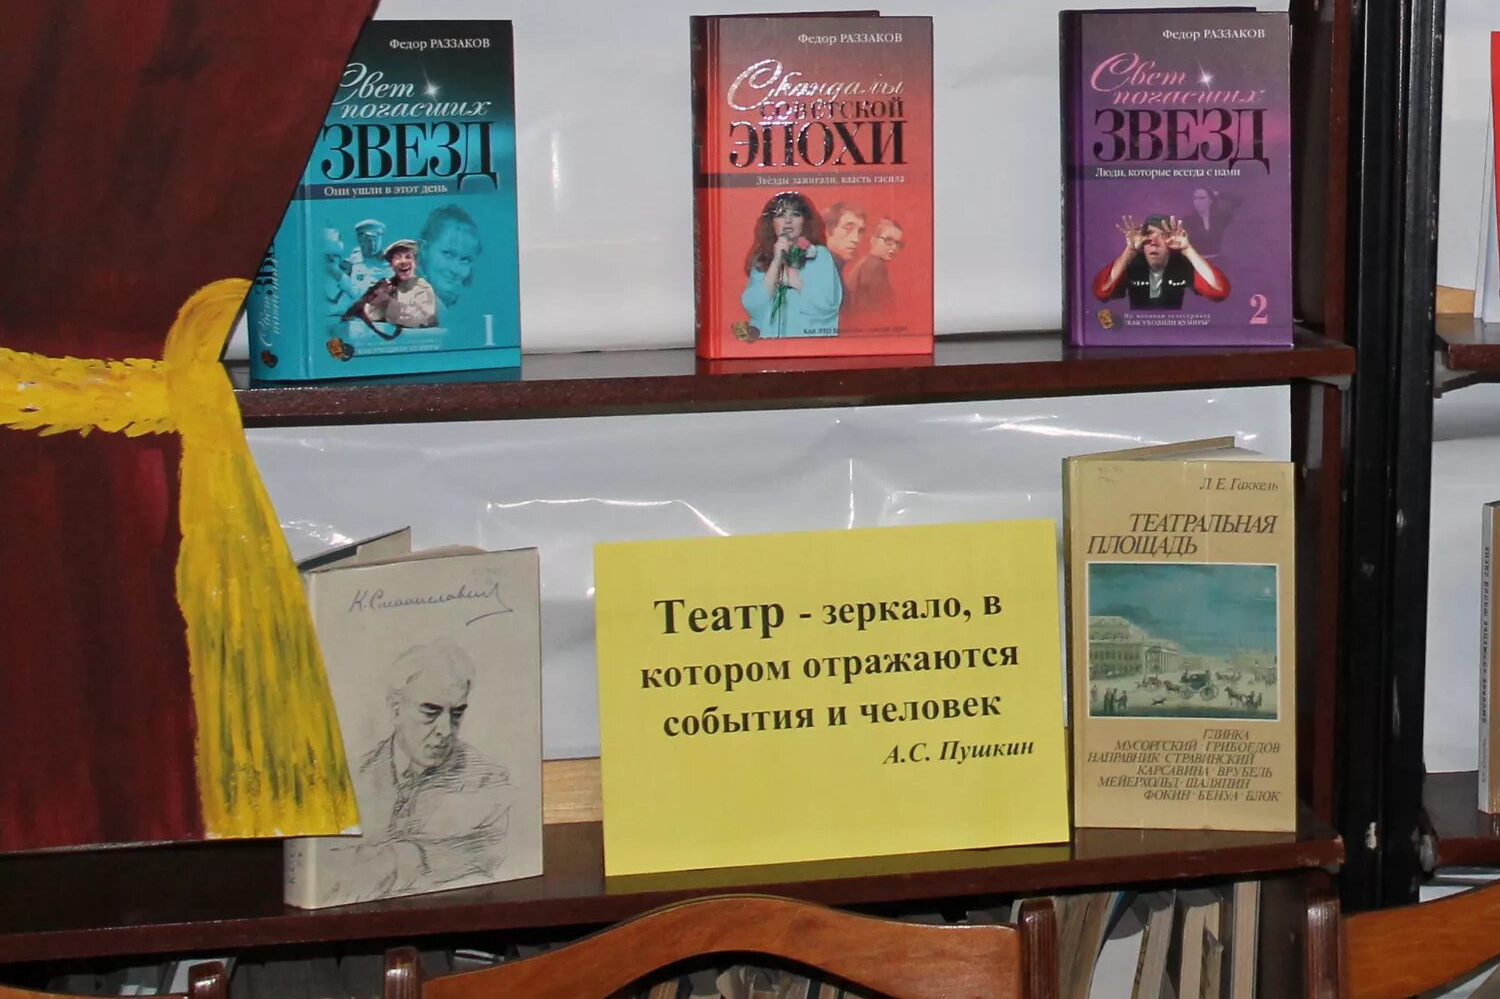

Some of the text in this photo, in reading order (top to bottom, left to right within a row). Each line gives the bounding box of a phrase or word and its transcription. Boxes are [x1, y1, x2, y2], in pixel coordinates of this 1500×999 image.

[389, 38, 490, 50] Федор РАЗЗАКОВ
[798, 32, 903, 44] Федор РАЗЗАКОВ
[1162, 28, 1265, 41] Федор РАЗЗАКОВ
[1091, 52, 1188, 93] Свет
[727, 59, 904, 111] Скандалы
[340, 97, 491, 120] погасших
[729, 120, 907, 168] ЭПОХИ
[1092, 107, 1270, 174] ЗВЕЗД
[320, 121, 498, 190] ЗВЕЗД
[1095, 168, 1240, 180] Люди, которые всегда с нами
[324, 185, 448, 198] Они ушли в этот день
[1249, 294, 1269, 325] 2
[483, 313, 496, 347] 1
[1230, 478, 1279, 491] Гаккель
[1129, 513, 1278, 535] ТЕАТРАЛЬНАЯ
[1087, 535, 1198, 558] ПЛОЩАДЬ
[653, 598, 785, 639] Театр
[822, 596, 971, 631] зеркало,
[982, 594, 1002, 616] в
[640, 645, 1019, 692] котором отражаются
[662, 695, 1001, 737] события и человек
[1114, 739, 1280, 753] МУСОРГСКИЙ ГРИБОЕДОВ
[1202, 729, 1250, 741] ГЛИНКА
[883, 740, 1035, 765] А.С. Пушкин
[1087, 752, 1255, 765] НАПРАВНИК СТРАВИНСКИЙ
[1098, 776, 1250, 789] МЕЙЕРХОЛЬД ШАЛЯПИН
[1137, 765, 1273, 778] КАРСАВИНА ВРУБЕЛЬ
[1144, 790, 1280, 801] ФОКИН БЕНУА БЛОК
